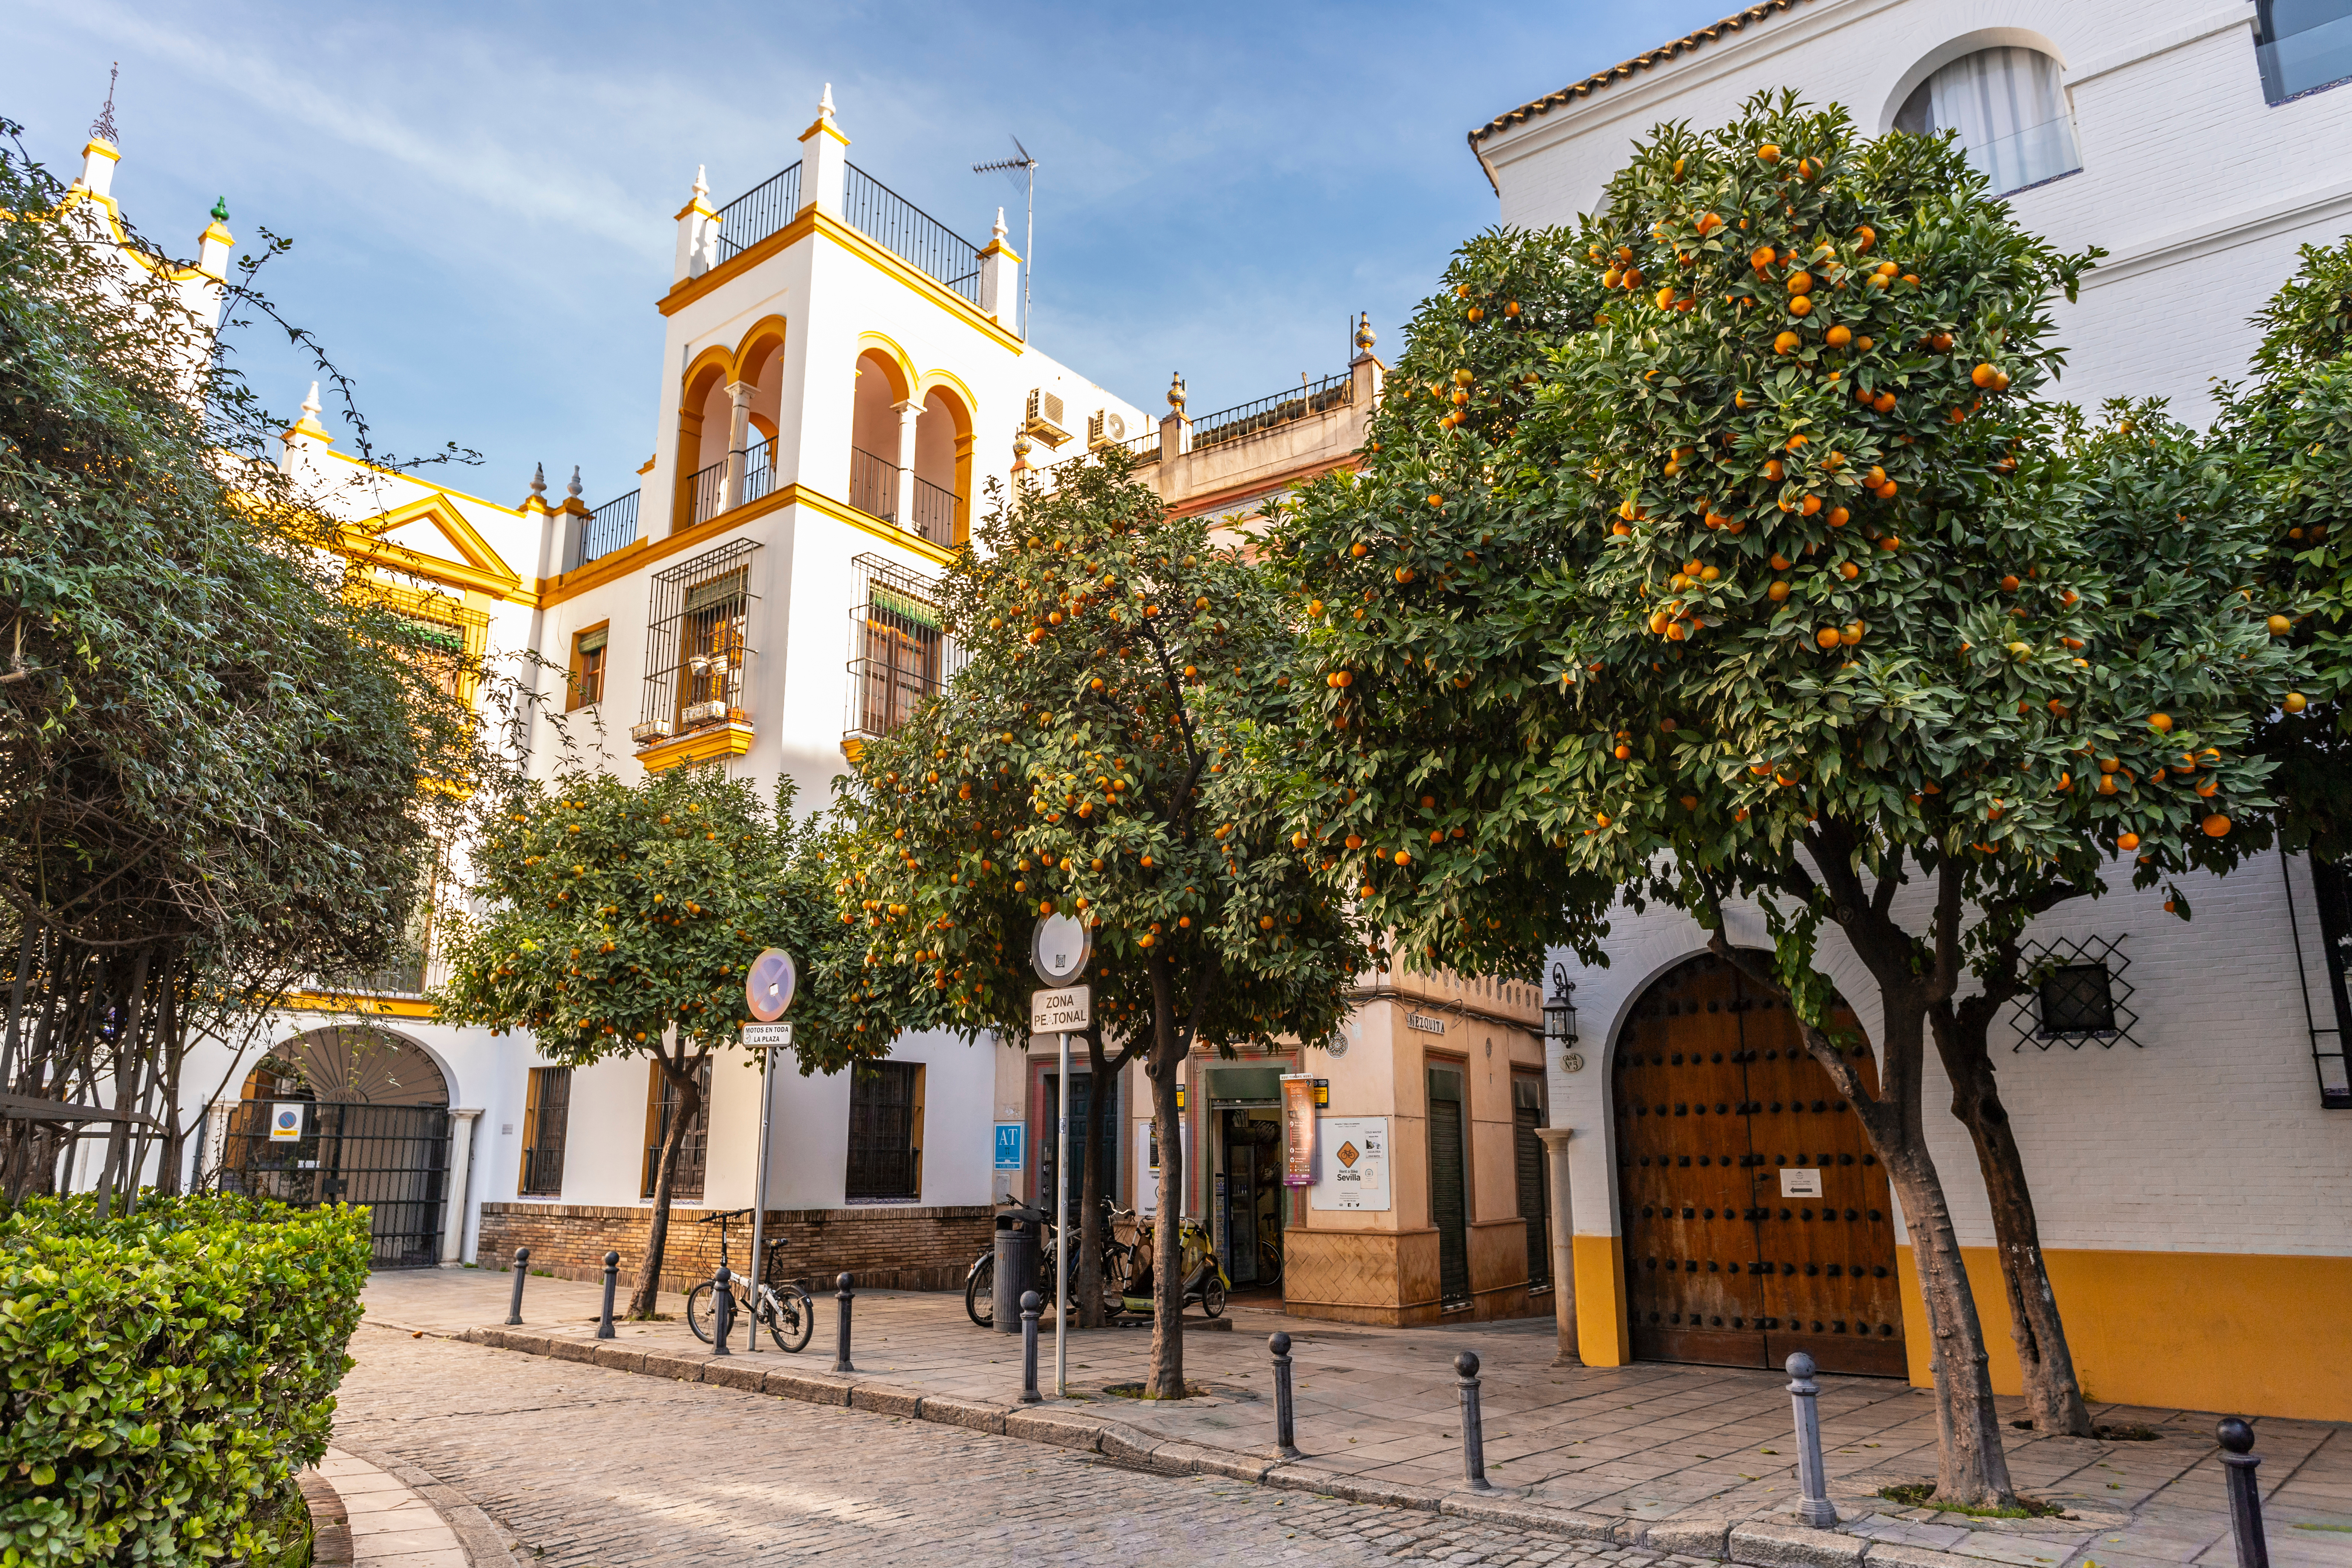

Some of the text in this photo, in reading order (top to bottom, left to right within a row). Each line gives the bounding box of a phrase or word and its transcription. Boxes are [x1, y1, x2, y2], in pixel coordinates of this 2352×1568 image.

[1046, 995, 1074, 1008] ZONA
[1034, 1010, 1086, 1026] PETONAL
[1410, 1015, 1445, 1033] MEZQUITA
[1573, 1061, 1578, 1070] 5
[998, 1129, 1017, 1145] AT
